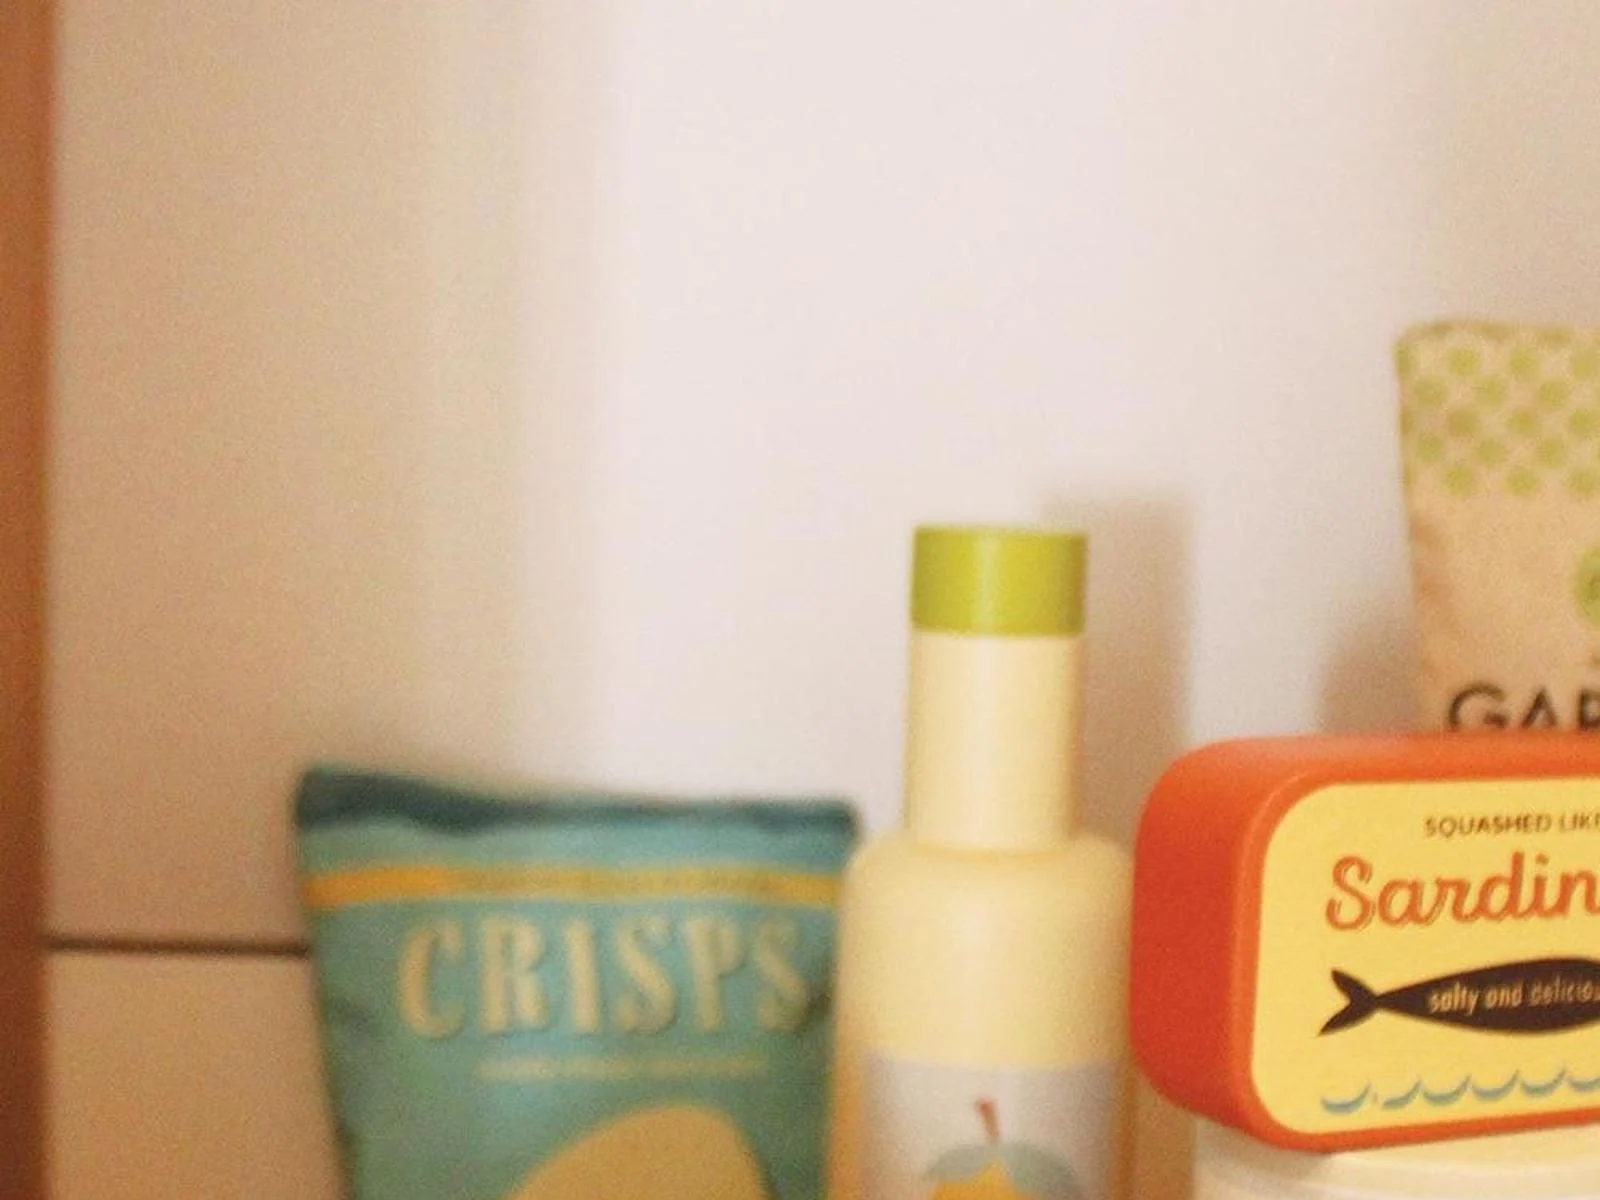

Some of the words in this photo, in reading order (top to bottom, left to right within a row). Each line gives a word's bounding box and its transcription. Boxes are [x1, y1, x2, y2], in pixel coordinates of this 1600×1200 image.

[1425, 812, 1552, 838] SQUASHED
[1325, 850, 1600, 931] Sardin
[402, 912, 811, 1038] CRISPS
[1429, 981, 1479, 1016] salty
[1485, 979, 1524, 1010] and
